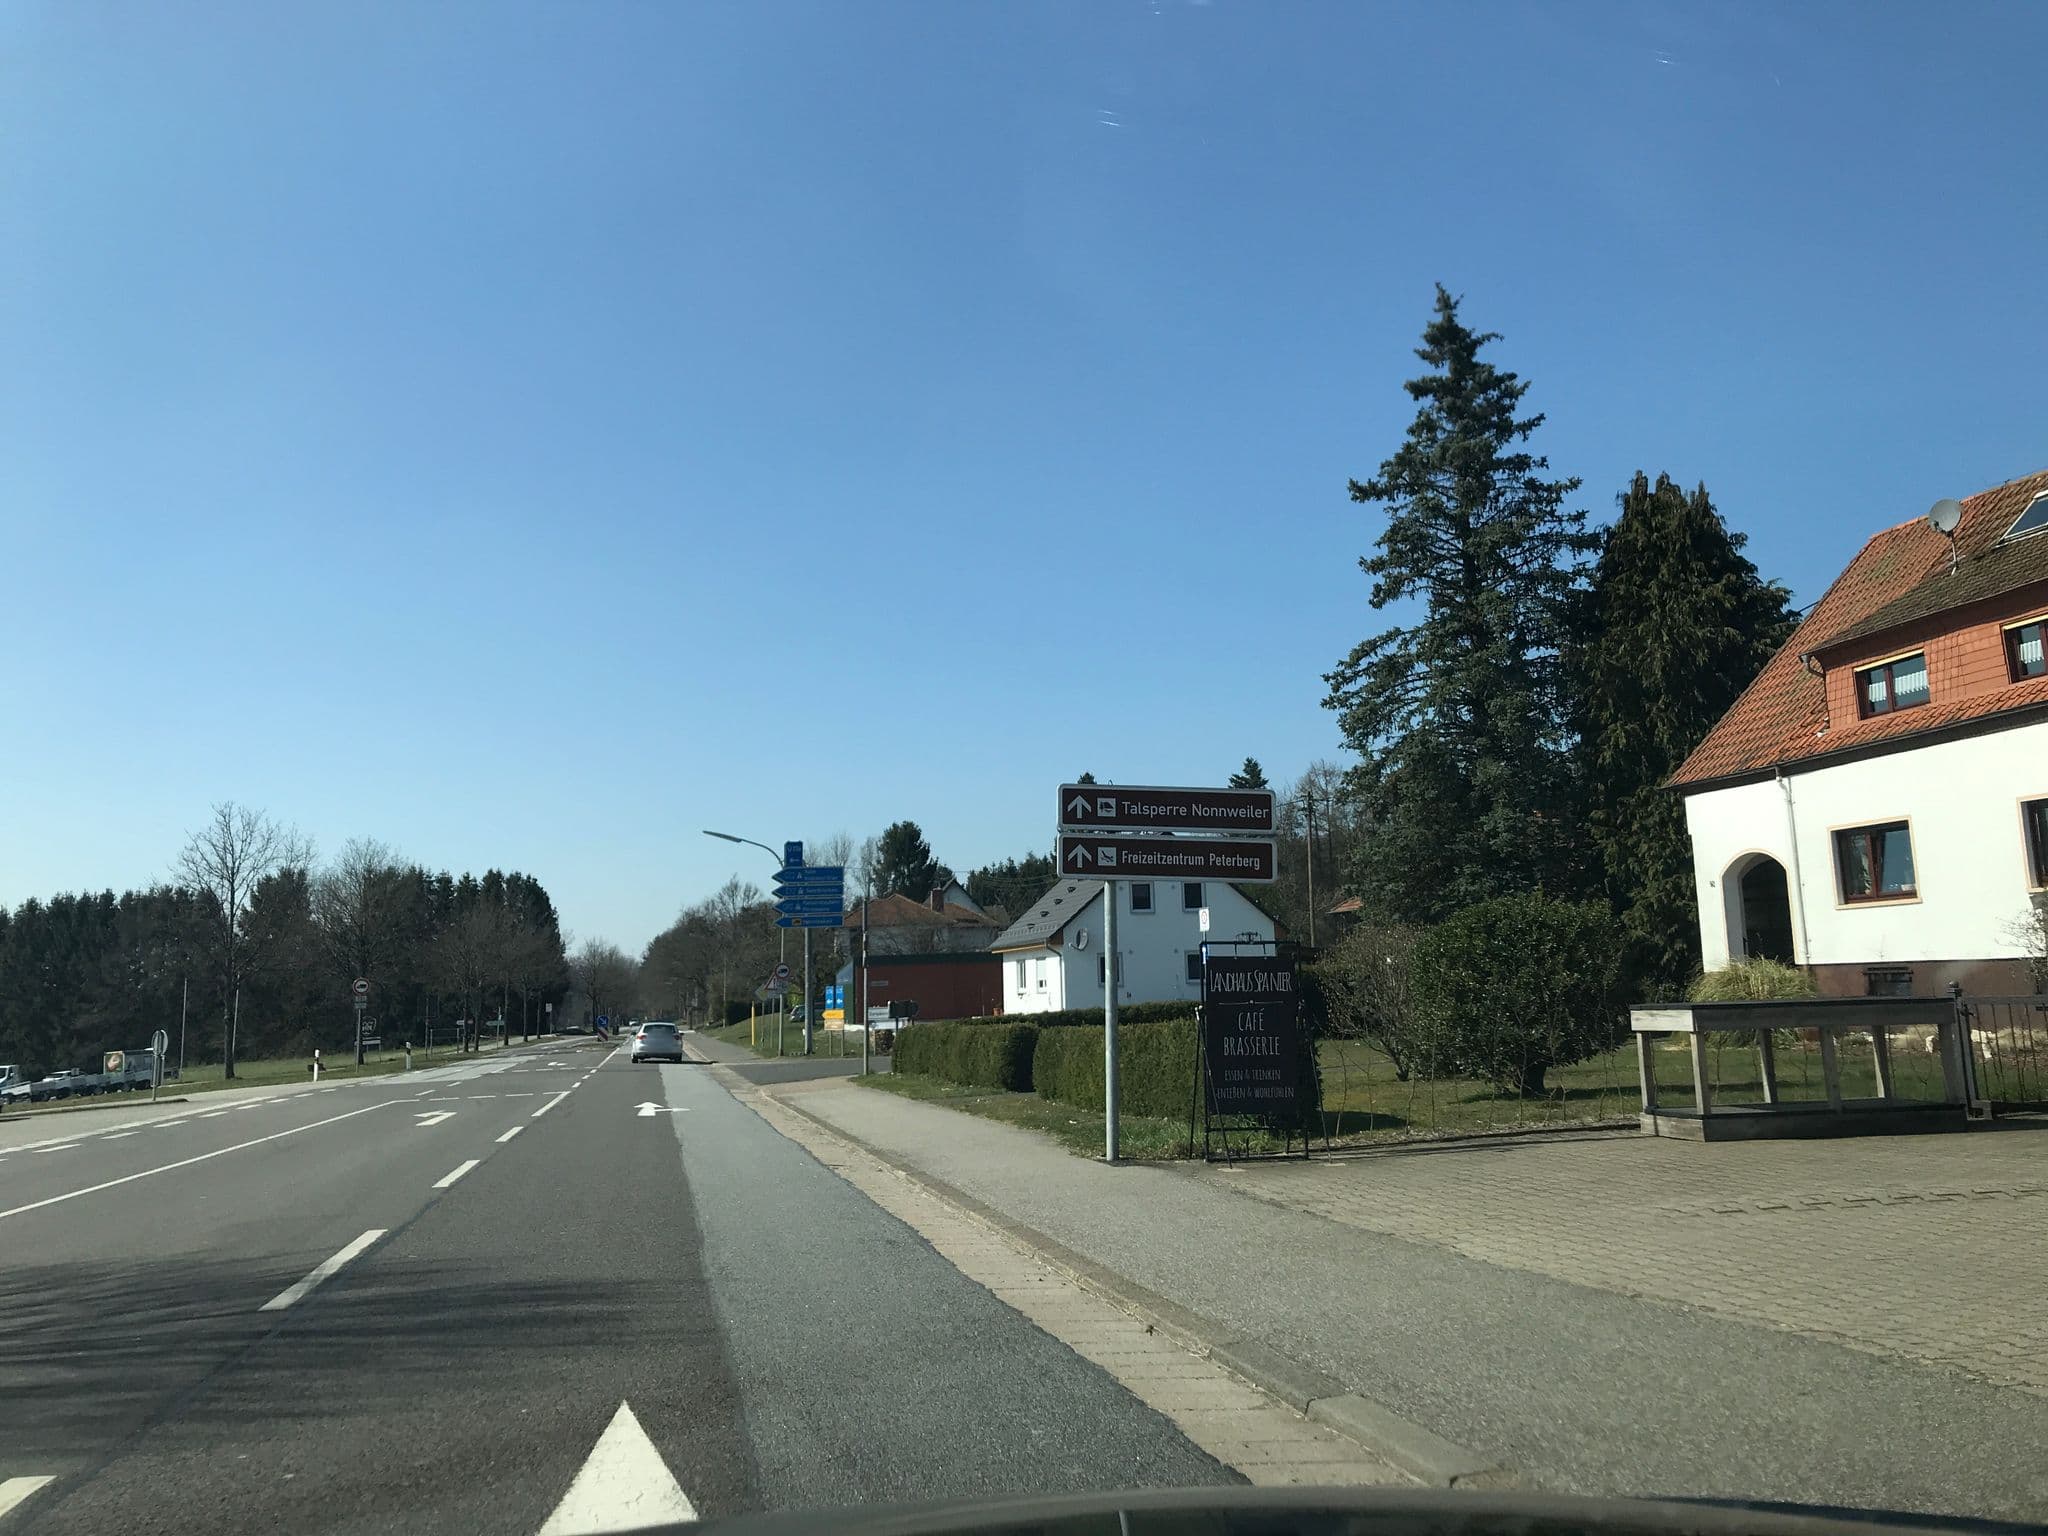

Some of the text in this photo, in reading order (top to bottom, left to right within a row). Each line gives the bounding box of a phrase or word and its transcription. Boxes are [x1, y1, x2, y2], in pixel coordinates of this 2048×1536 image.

[1121, 801, 1269, 819] Talsperre Nonnweiler
[1121, 850, 1260, 871] Freizeitzentrum Peterberg
[1238, 1008, 1265, 1032] CAFÉ
[1223, 1036, 1280, 1056] BRASSERIE
